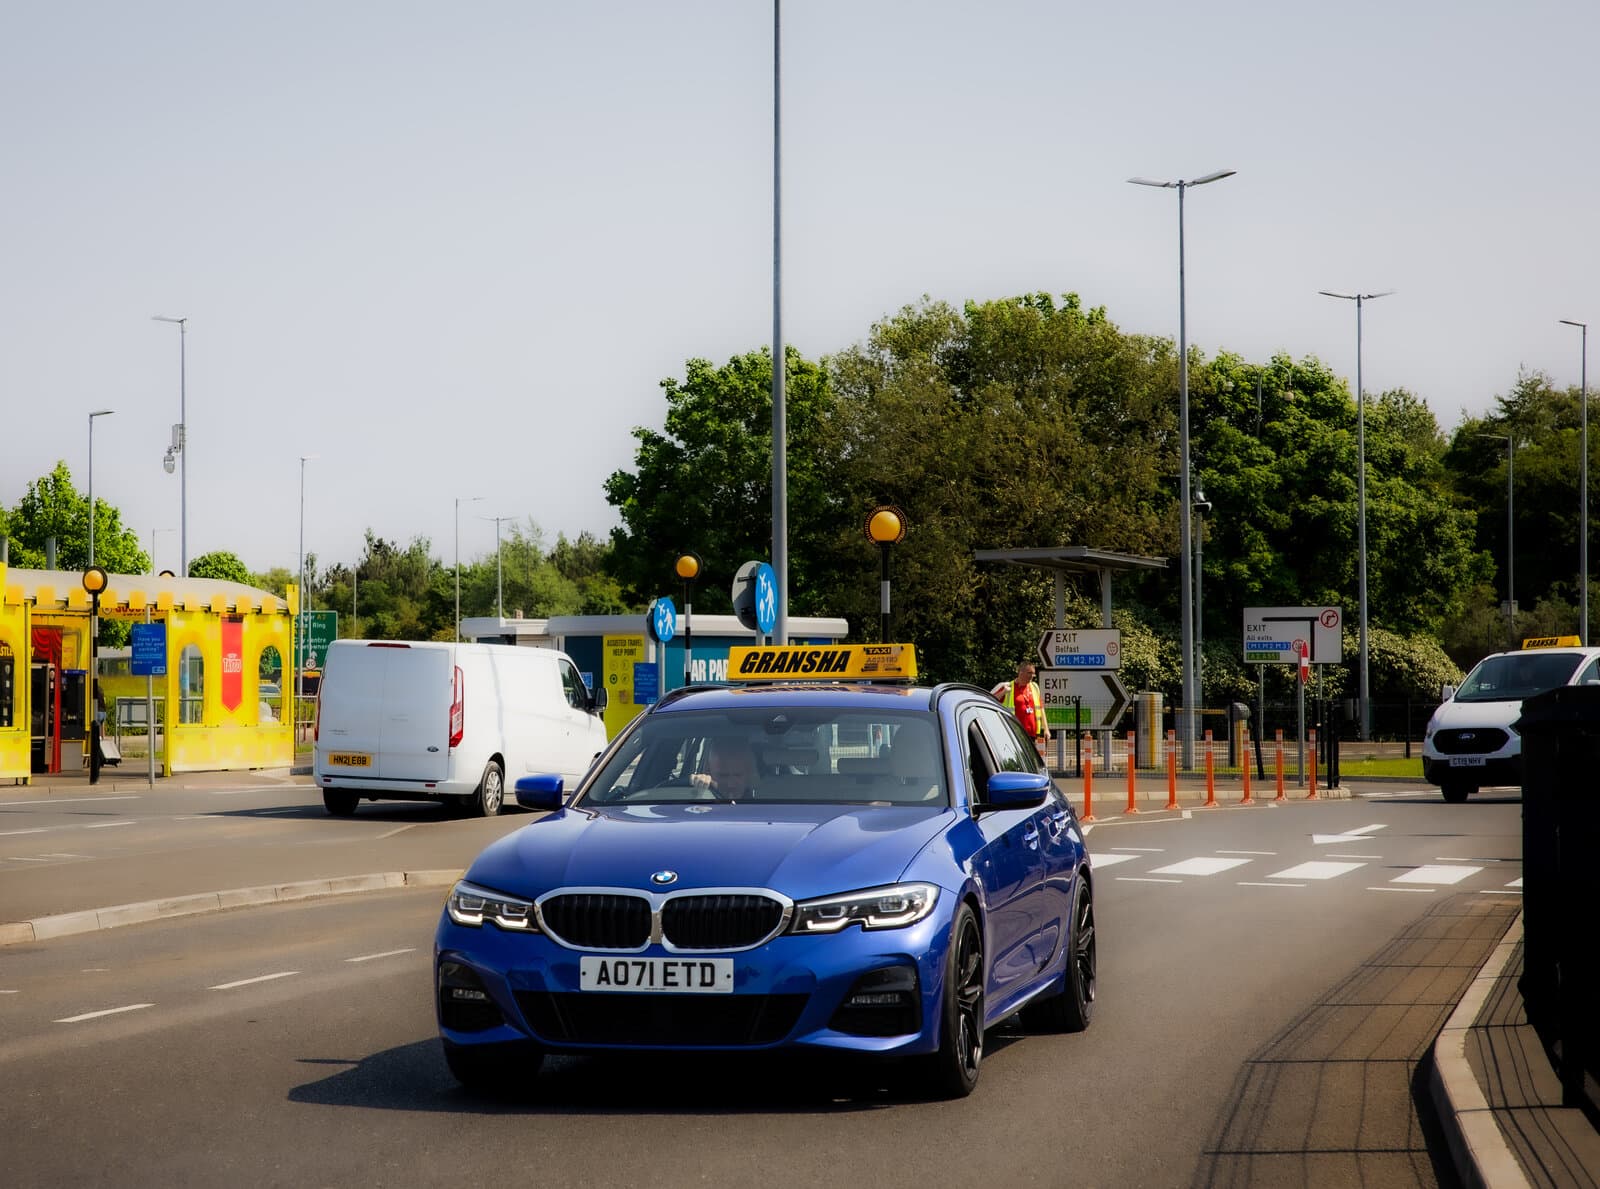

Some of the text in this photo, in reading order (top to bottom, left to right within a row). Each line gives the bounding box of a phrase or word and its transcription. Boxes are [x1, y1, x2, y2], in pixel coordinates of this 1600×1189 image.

[1247, 624, 1266, 632] EXIT
[1055, 633, 1077, 643] EXIT
[1526, 638, 1559, 649] GRANSHA
[1055, 645, 1080, 653] Belfast
[739, 650, 852, 674] GRANSHA
[684, 659, 729, 681] AR PAR
[1044, 678, 1068, 689] EXIT
[1044, 692, 1083, 706] Bangor
[663, 961, 716, 988] ETD
